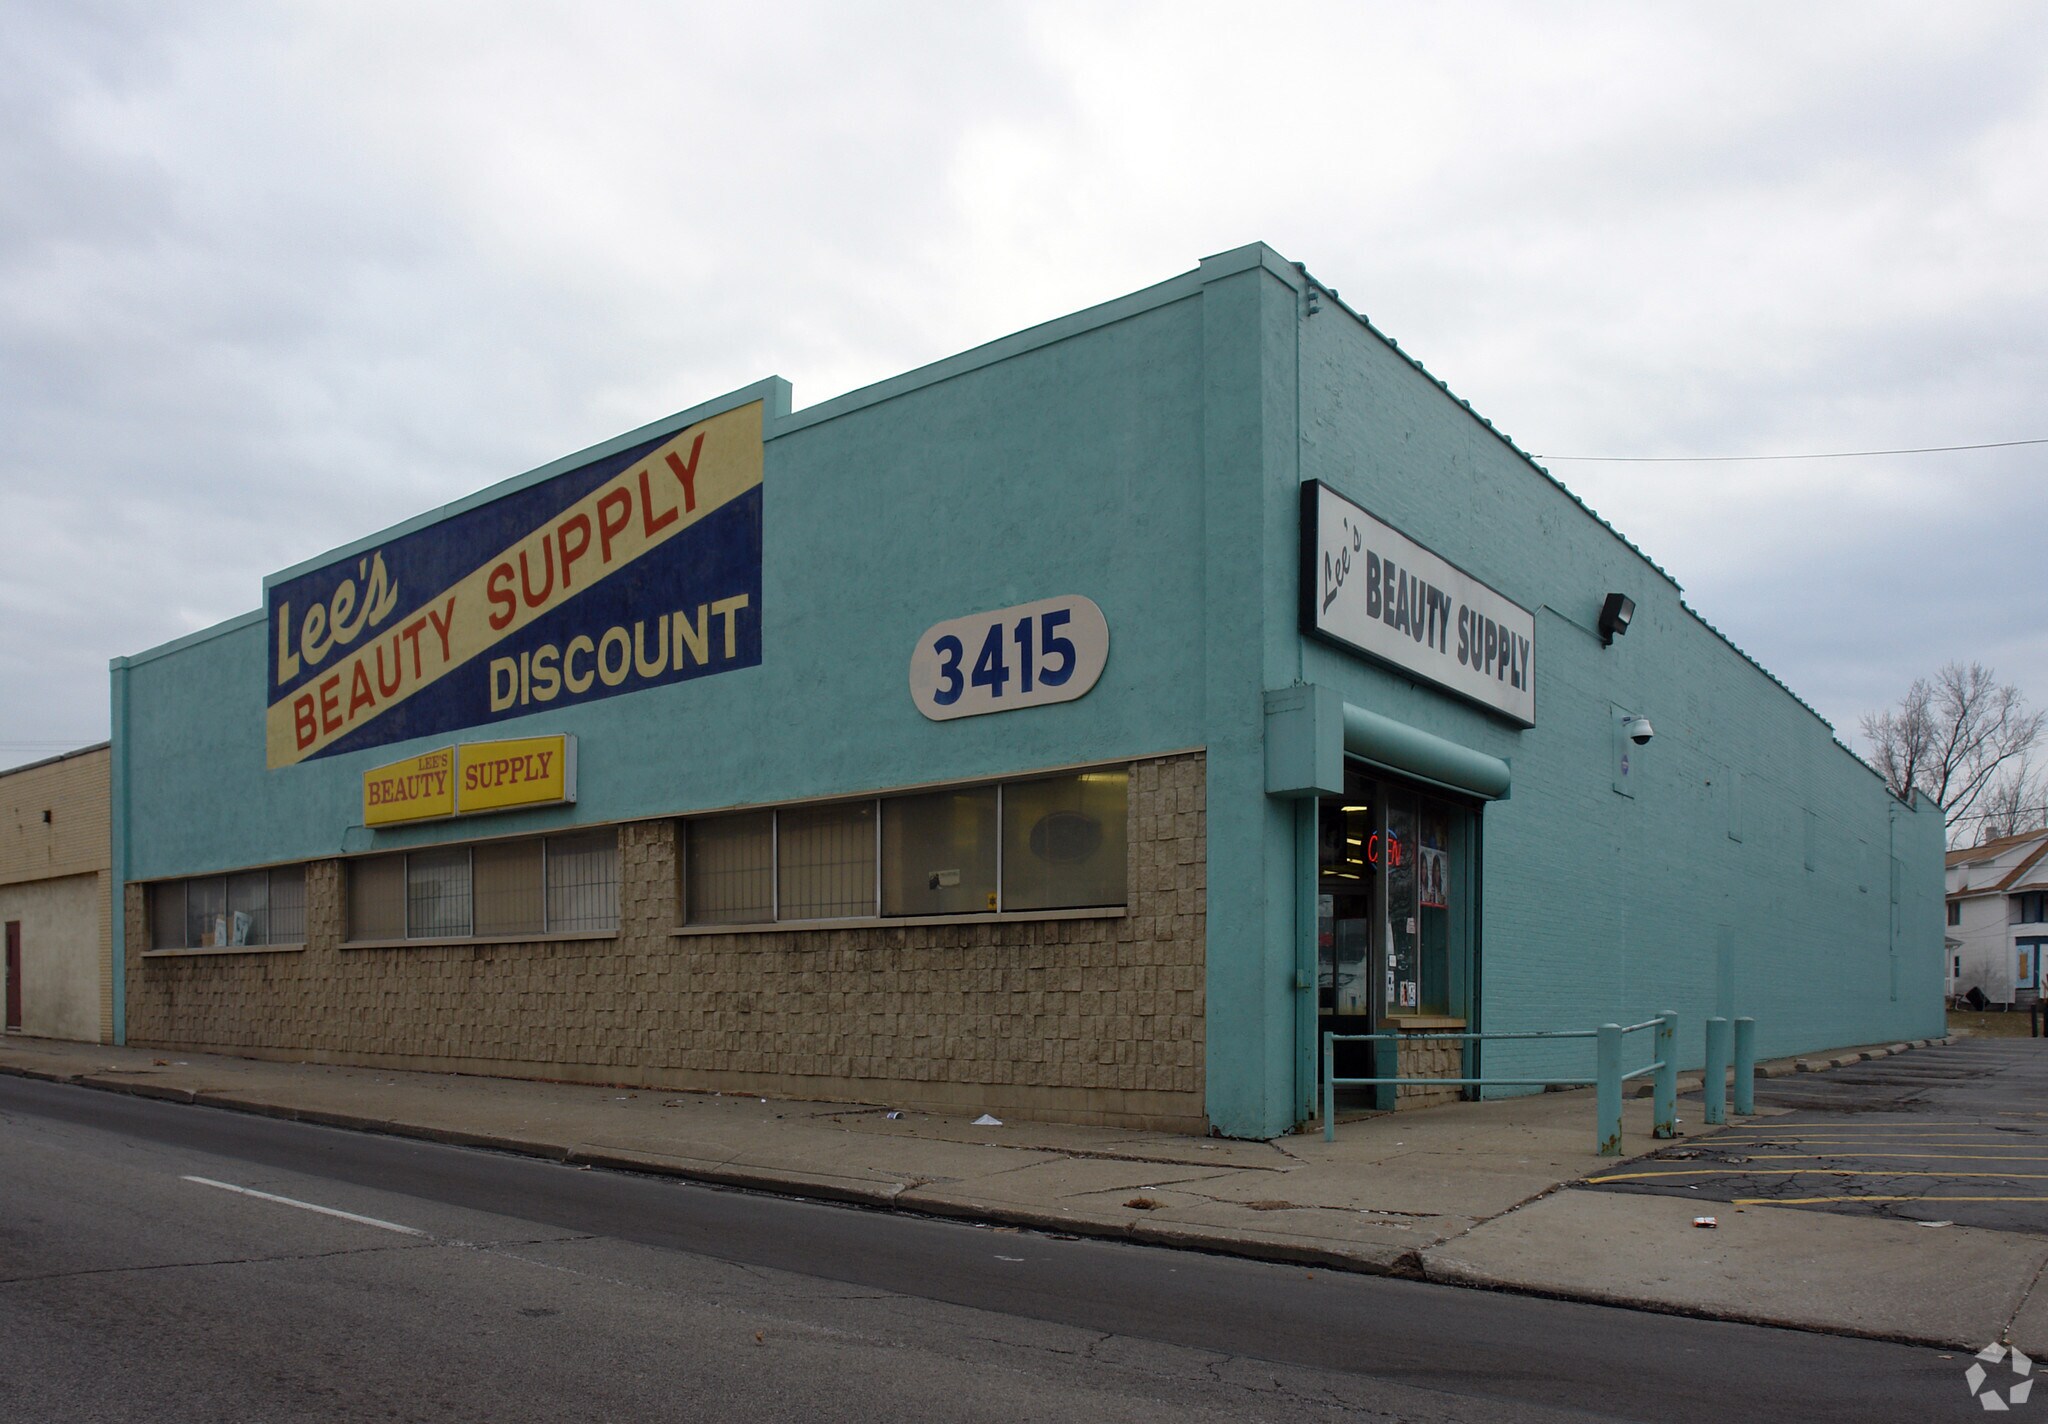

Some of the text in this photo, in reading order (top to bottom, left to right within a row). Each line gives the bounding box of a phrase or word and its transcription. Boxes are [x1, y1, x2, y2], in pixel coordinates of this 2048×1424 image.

[277, 550, 398, 686] Lee's
[293, 431, 706, 751] BEAUTY SUPPLY
[1323, 517, 1530, 692] Lee's BEAUTY SUPPLY
[489, 593, 750, 712] DISCOUNT
[933, 608, 1077, 705] 3415
[368, 751, 553, 806] BEAUTY SUPPLY
[418, 753, 449, 771] LEE'S
